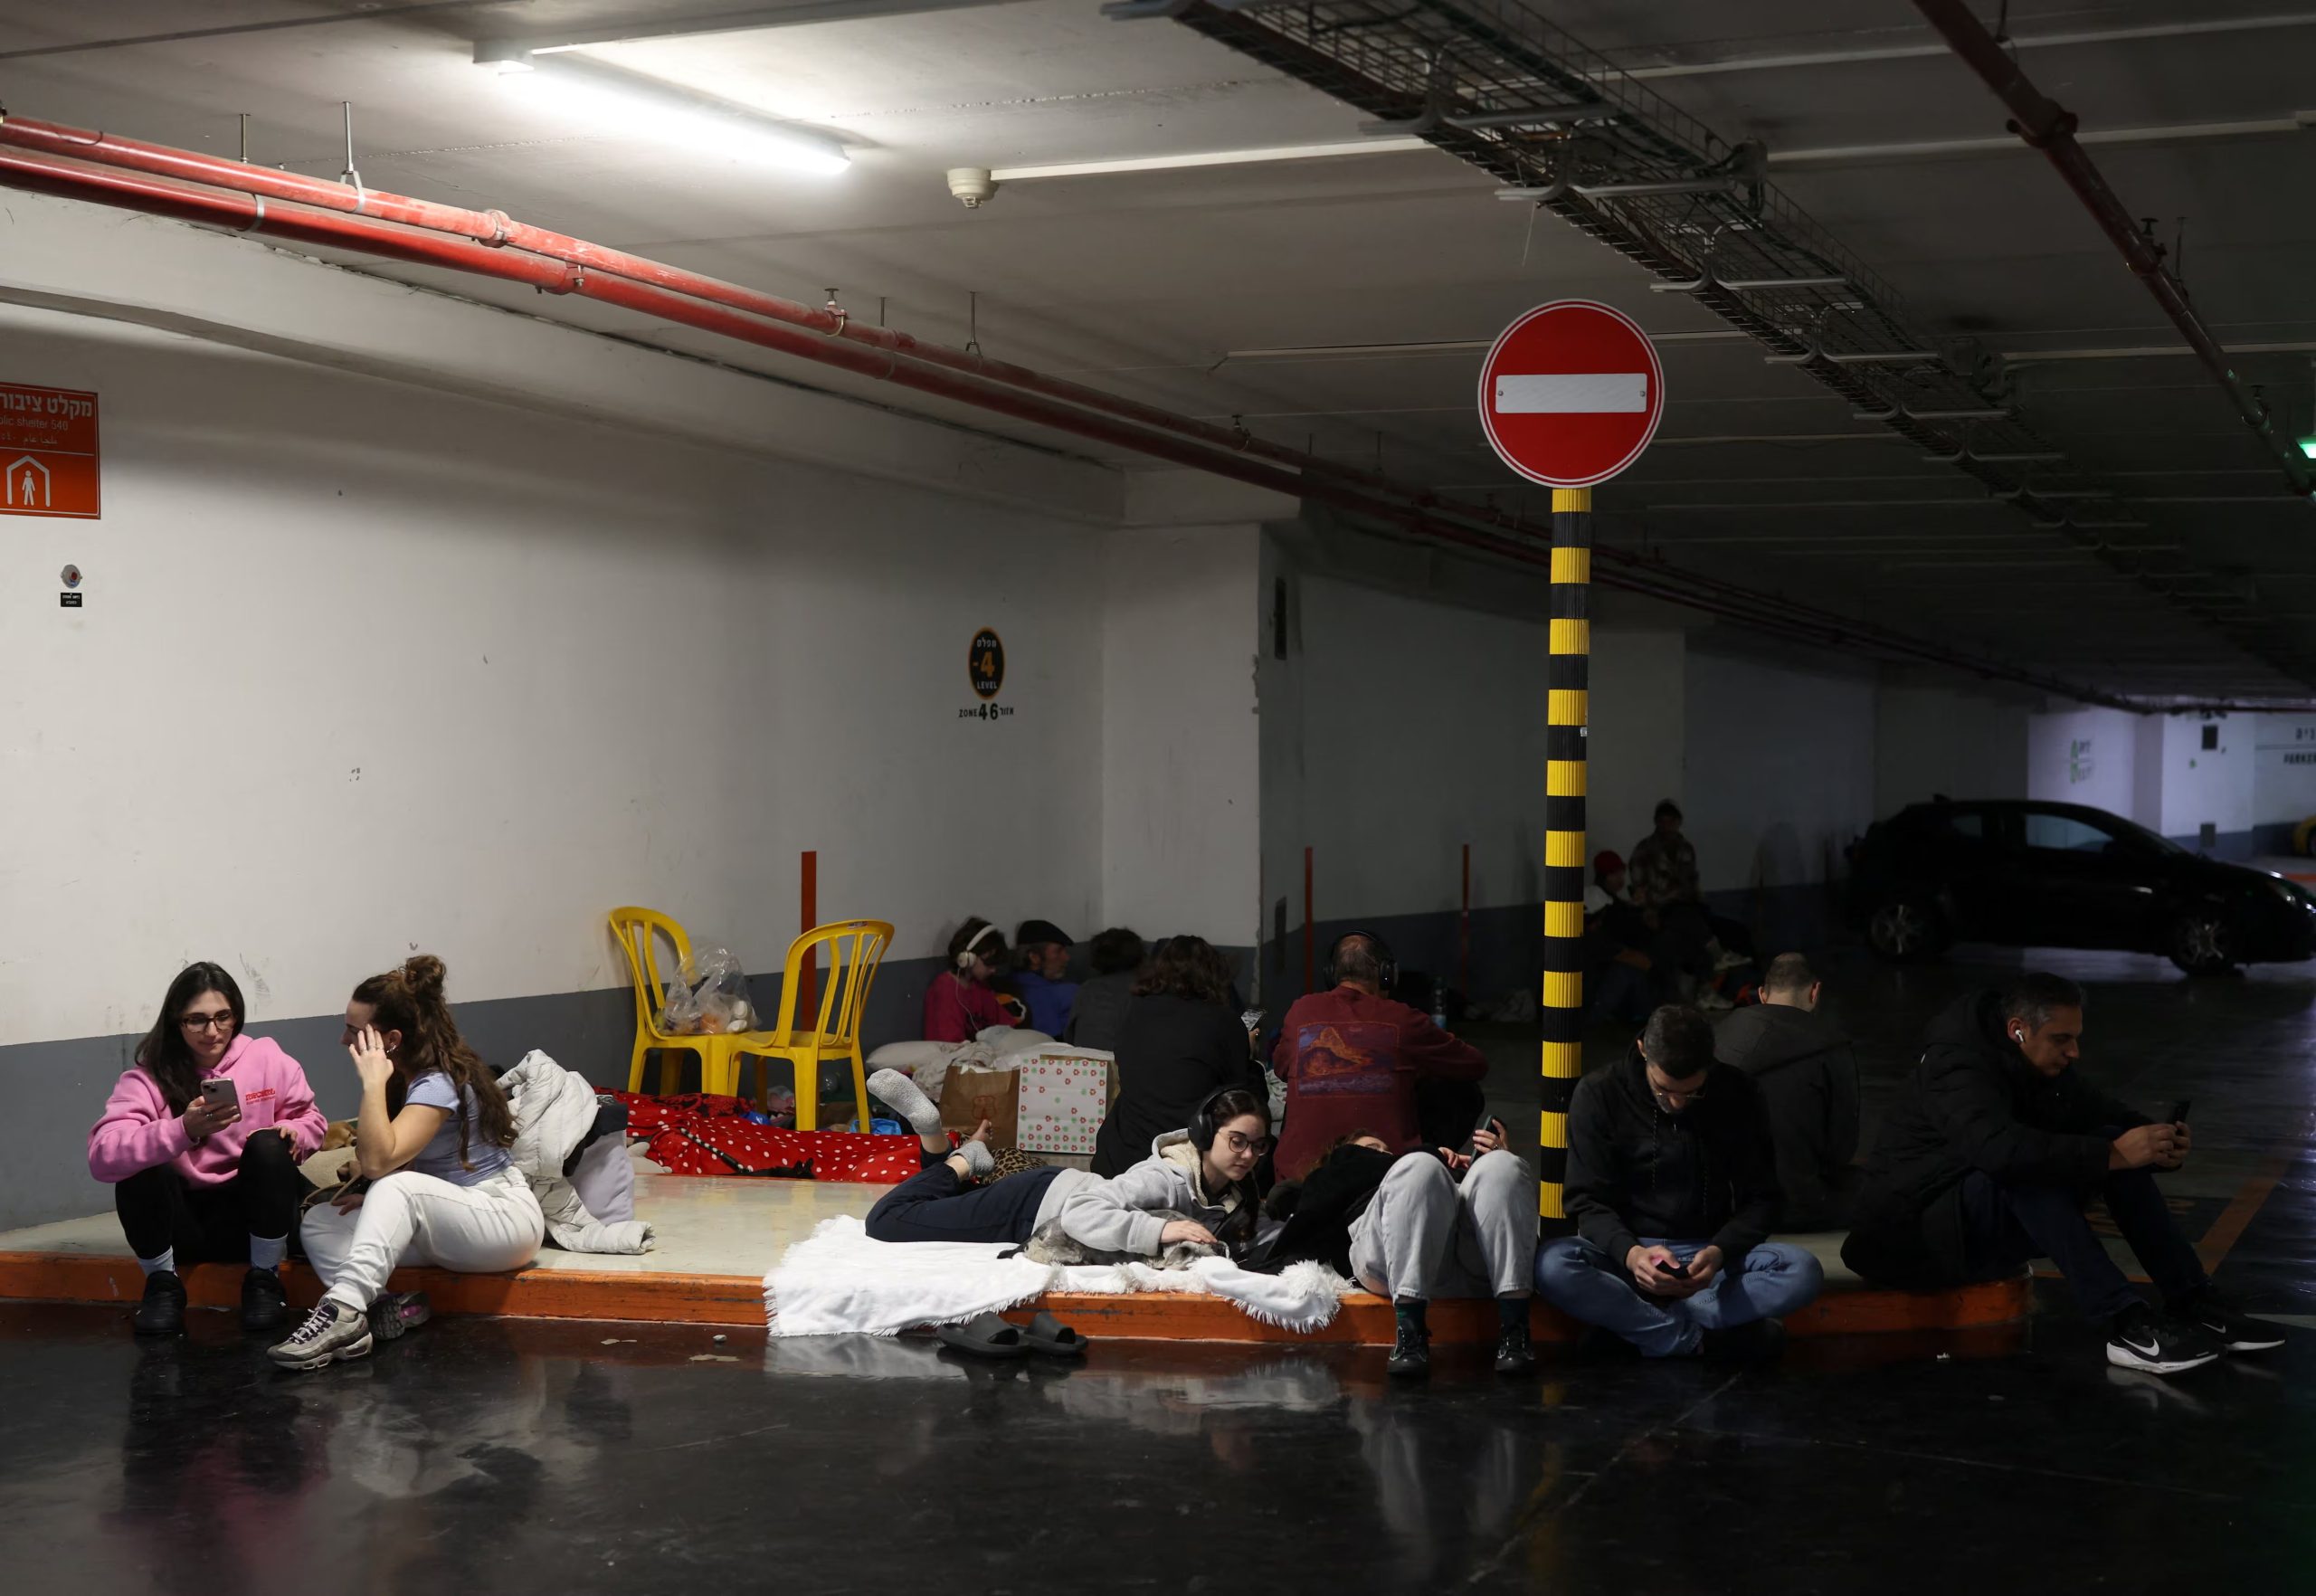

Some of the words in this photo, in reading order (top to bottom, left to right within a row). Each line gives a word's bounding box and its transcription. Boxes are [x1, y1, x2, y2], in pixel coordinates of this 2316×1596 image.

[0, 393, 42, 413] ציבור
[47, 394, 93, 420] מקלט
[17, 415, 48, 429] shelter
[51, 419, 69, 431] 540
[977, 680, 998, 689] LEVEL
[959, 708, 978, 717] ZONE
[979, 703, 999, 720] 46
